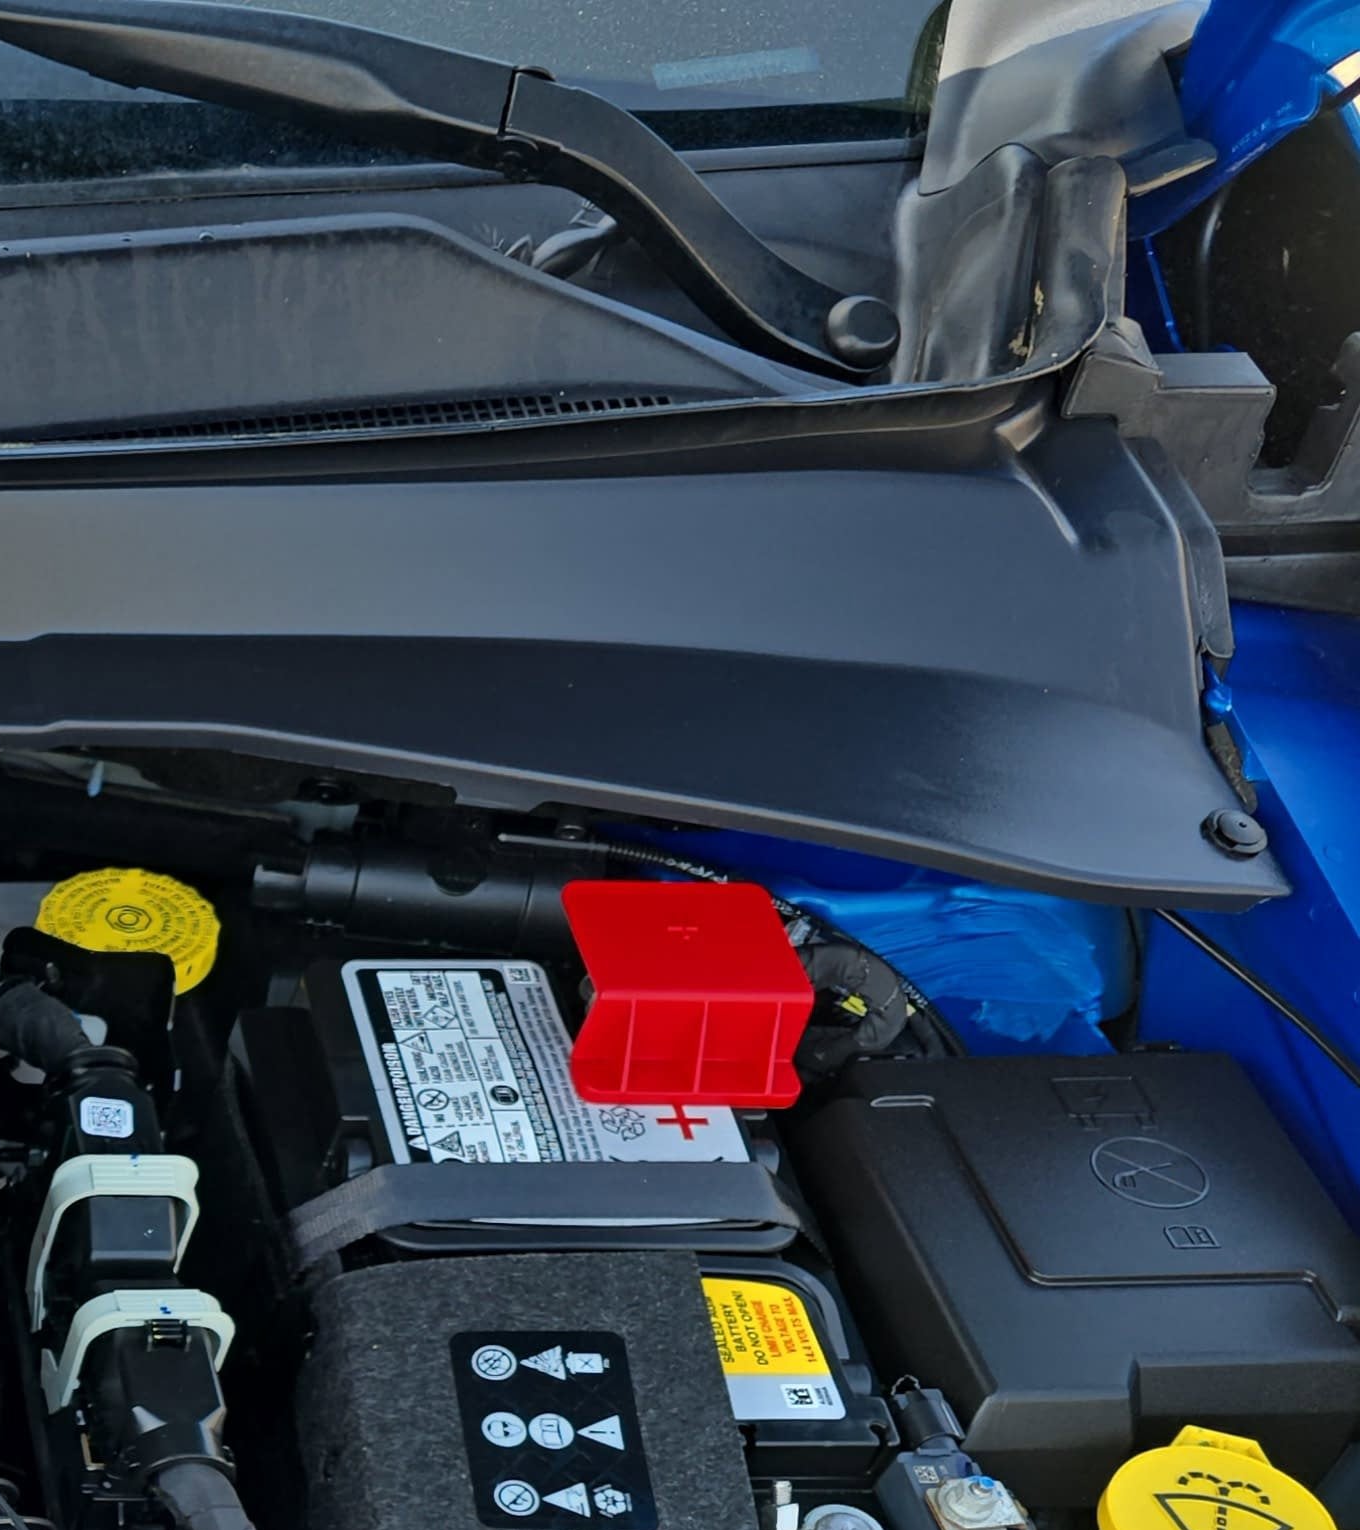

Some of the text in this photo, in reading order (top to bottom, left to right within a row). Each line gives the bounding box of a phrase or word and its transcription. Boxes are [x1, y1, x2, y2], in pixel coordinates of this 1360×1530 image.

[380, 1042, 422, 1134] DANGER/POISON
[712, 1321, 735, 1363] SEALED
[720, 1304, 747, 1353] BATTERY
[731, 1290, 769, 1366] DO NOT OPEN!
